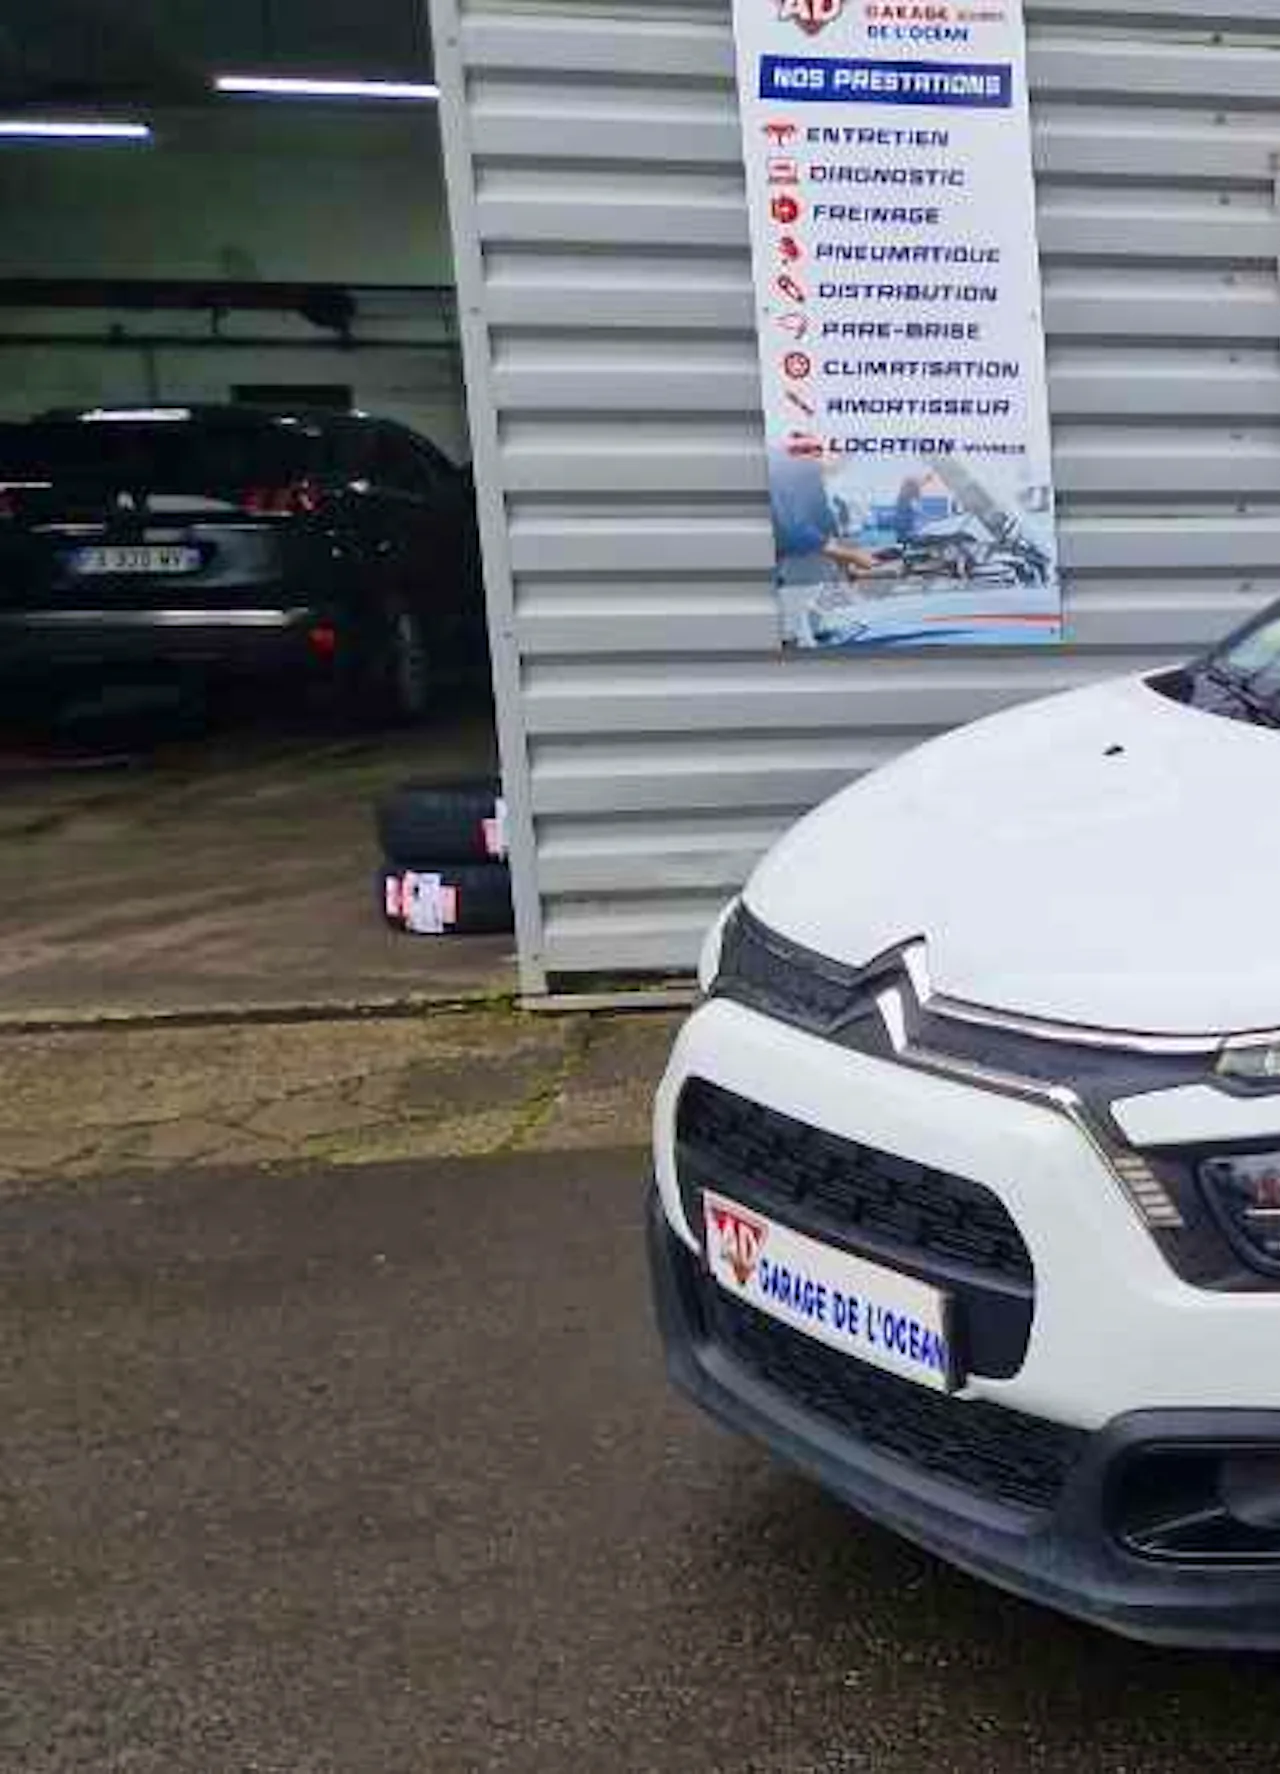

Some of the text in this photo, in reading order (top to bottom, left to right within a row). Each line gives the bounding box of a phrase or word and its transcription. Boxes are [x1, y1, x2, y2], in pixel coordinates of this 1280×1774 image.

[866, 4, 949, 20] GARAGE
[867, 25, 890, 39] DE
[773, 66, 1001, 95] NOS PRESTATIONS
[806, 127, 949, 147] ENTRETIEN
[808, 165, 964, 186] DIAGNOSTIC
[812, 204, 940, 224] FREINAGE
[816, 244, 1000, 264] PNEUMATIQUE
[819, 283, 998, 301] DISTRIBUTION
[822, 321, 981, 340] PARE-BRISE
[823, 360, 1020, 379] CLIMATISATION
[826, 399, 1011, 416] AMORTISSEUR
[829, 438, 954, 455] LOCATION
[758, 1258, 949, 1374] GARAGE DE L'OCEAN
